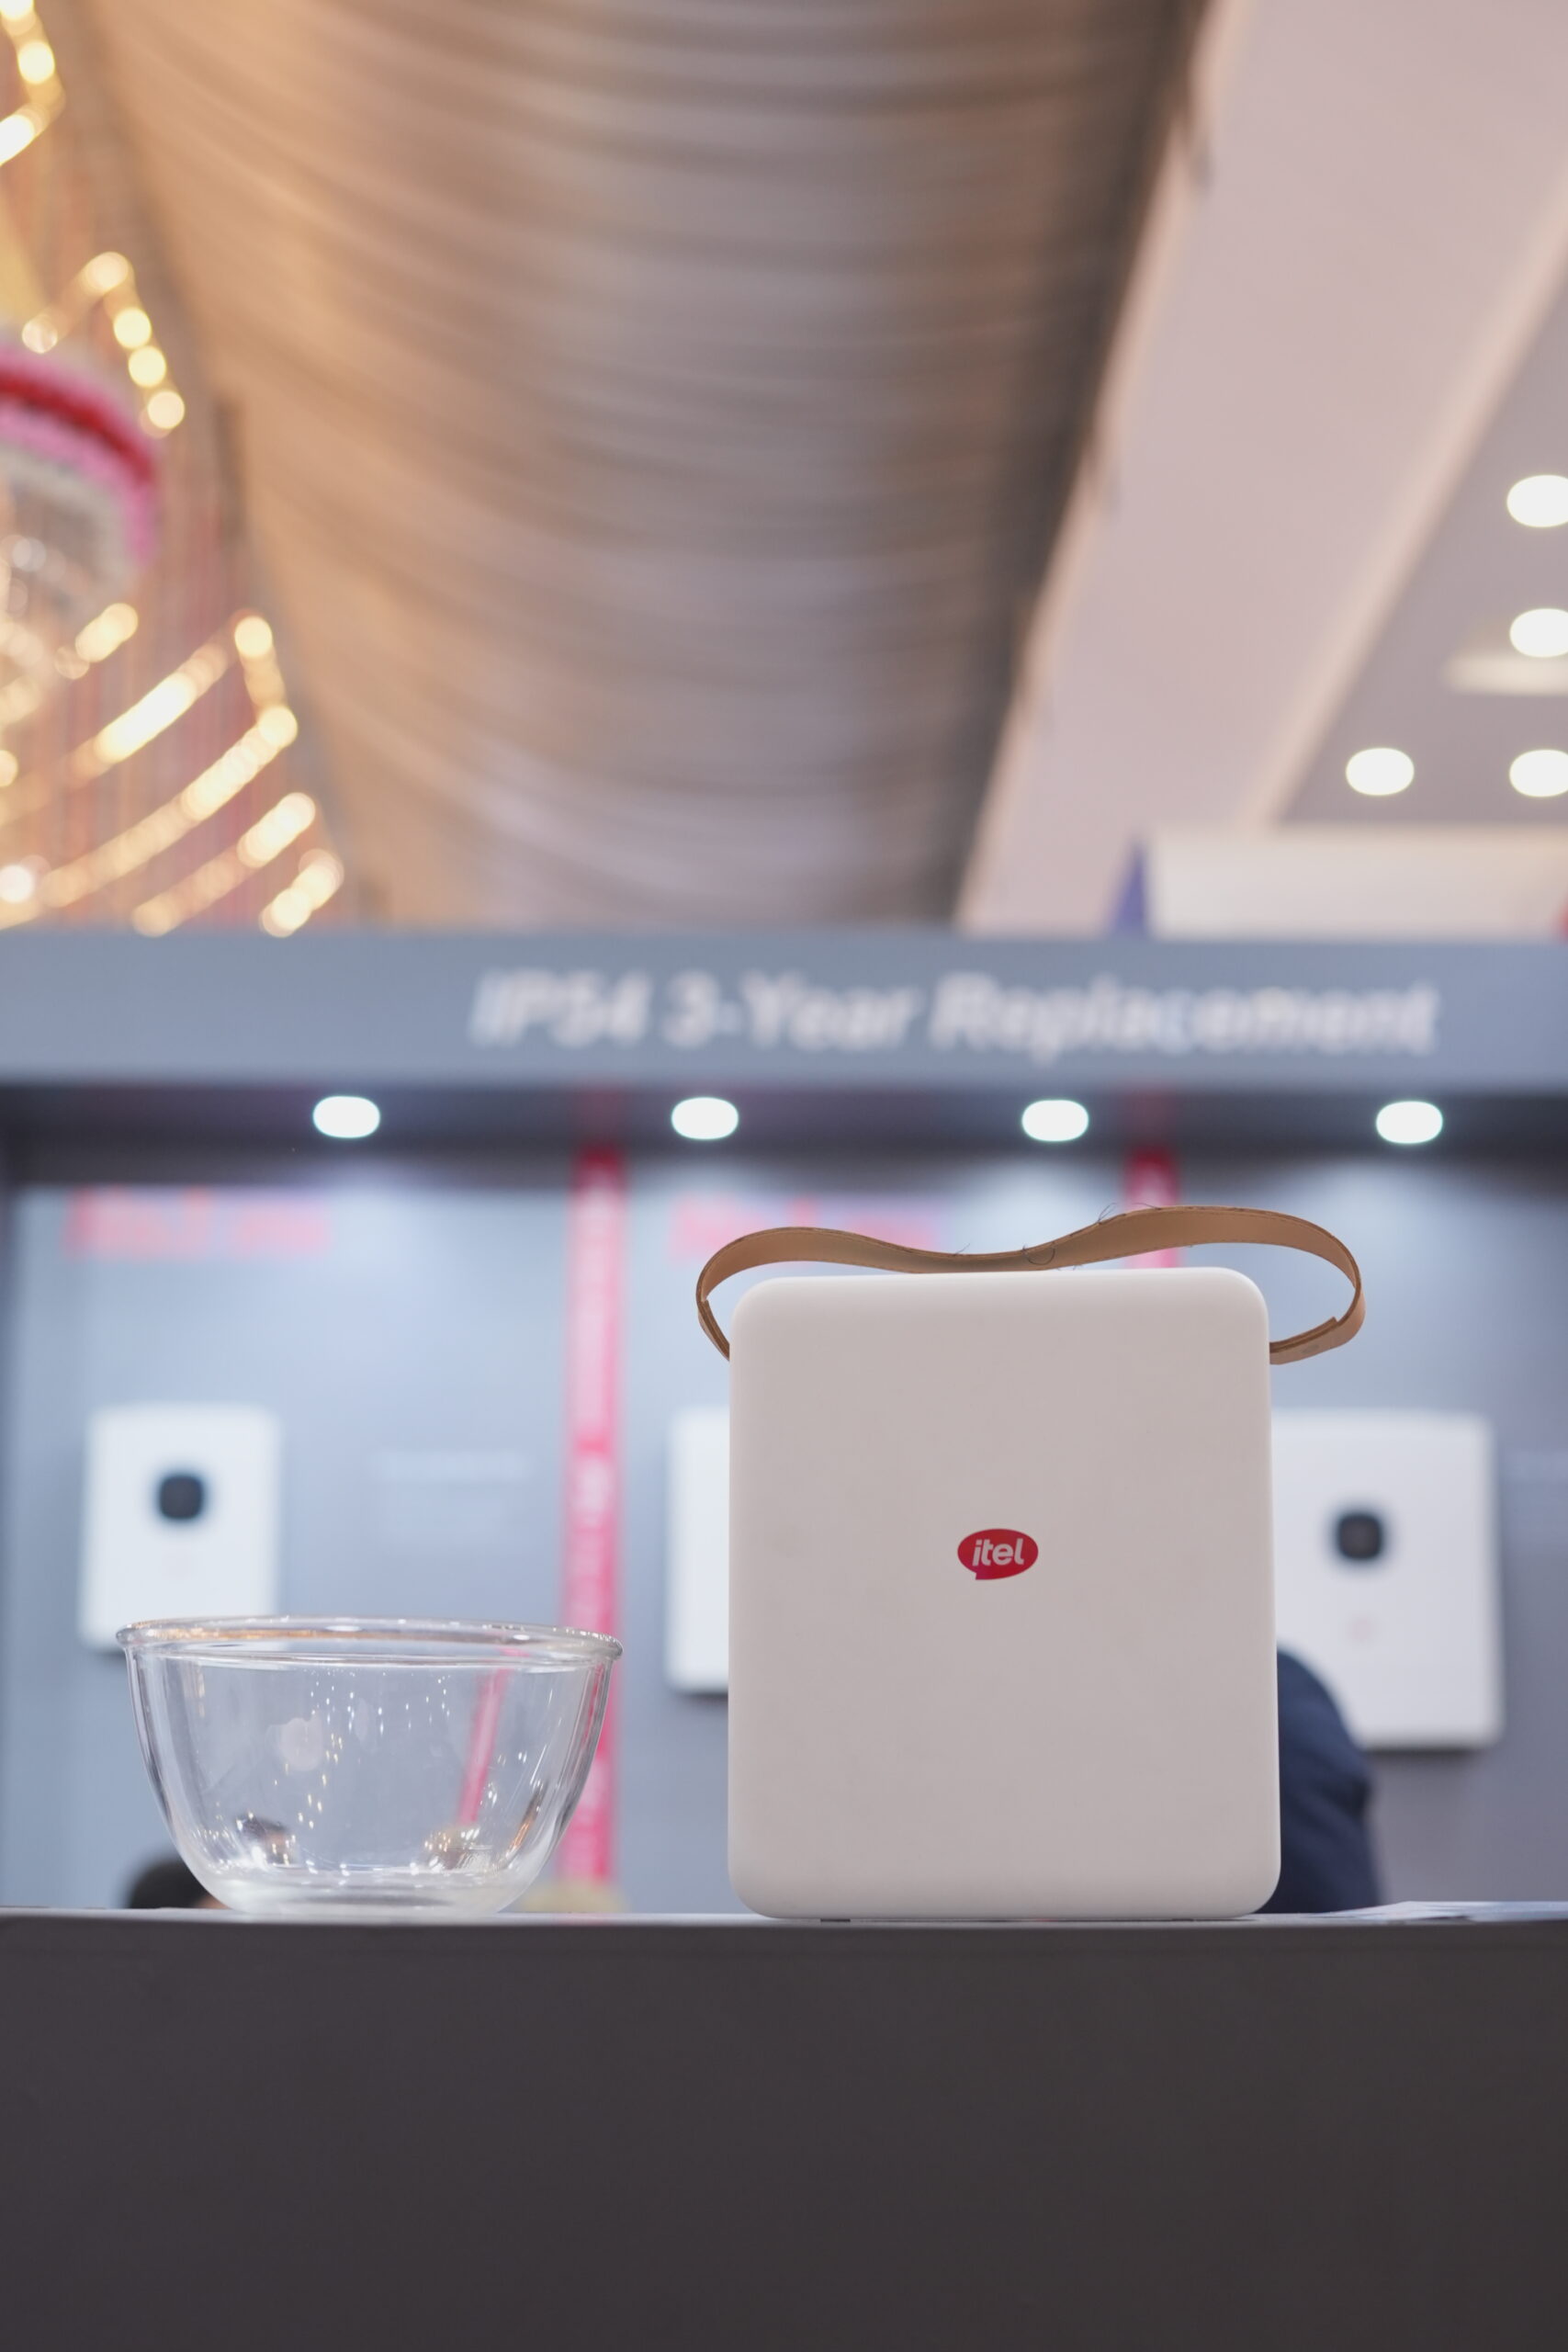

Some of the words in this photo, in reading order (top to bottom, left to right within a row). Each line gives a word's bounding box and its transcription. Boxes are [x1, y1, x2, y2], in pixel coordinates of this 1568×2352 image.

[662, 971, 920, 1051] 3-Year
[930, 970, 1439, 1063] Replacement
[972, 1538, 1024, 1566] itel
